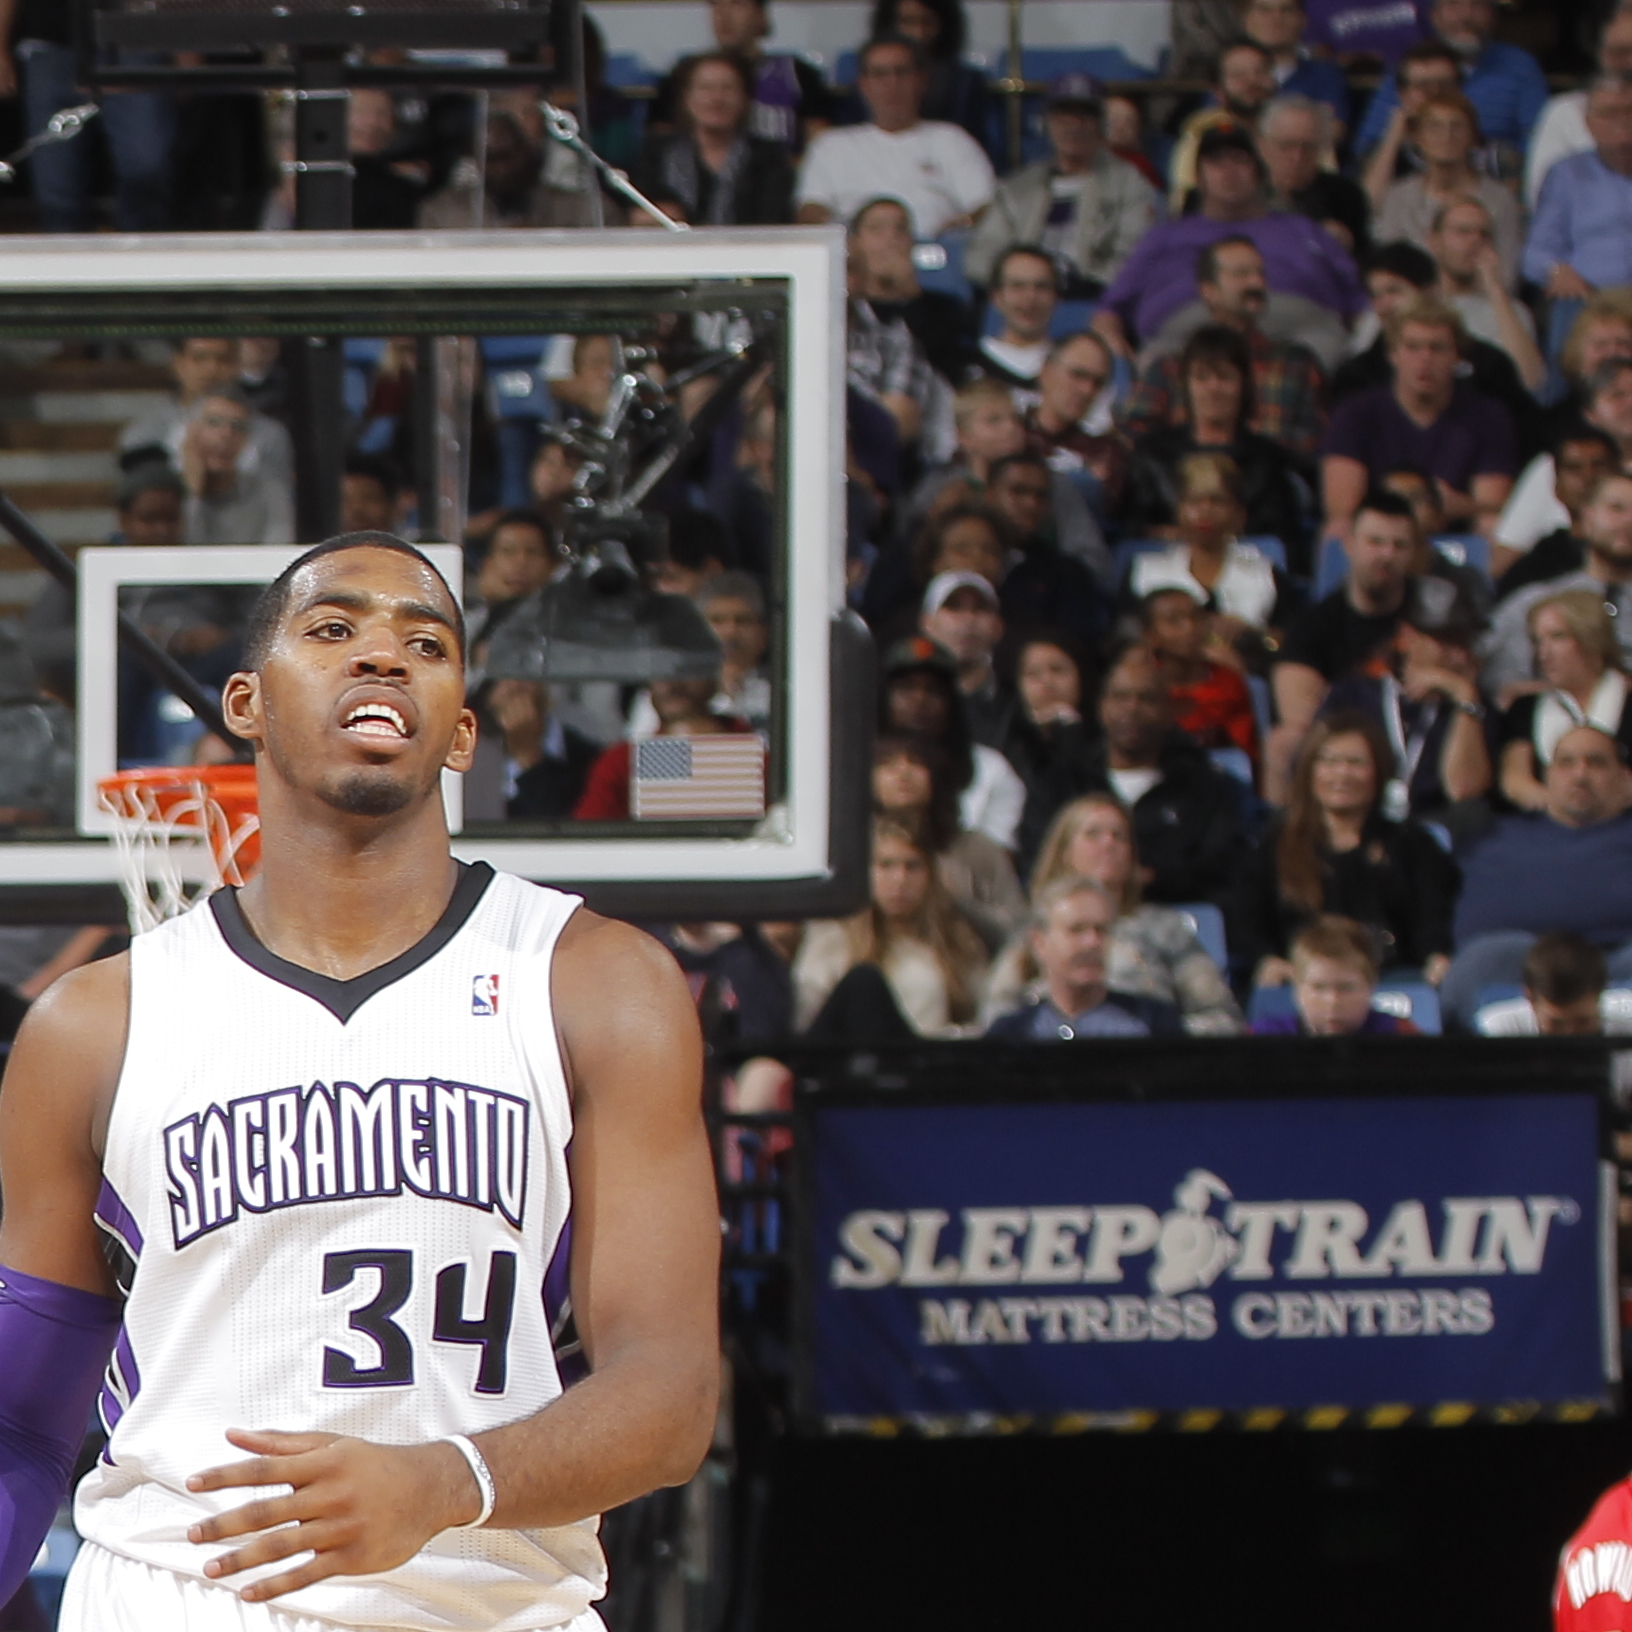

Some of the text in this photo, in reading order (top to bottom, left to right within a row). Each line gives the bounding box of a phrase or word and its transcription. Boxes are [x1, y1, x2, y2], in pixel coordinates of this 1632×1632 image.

[163, 1076, 531, 1252] SACRAMENTO
[830, 1198, 1558, 1288] SLEEP TRAIN
[320, 1247, 519, 1396] 34
[921, 1288, 1495, 1346] MATTRESS CENTERS
